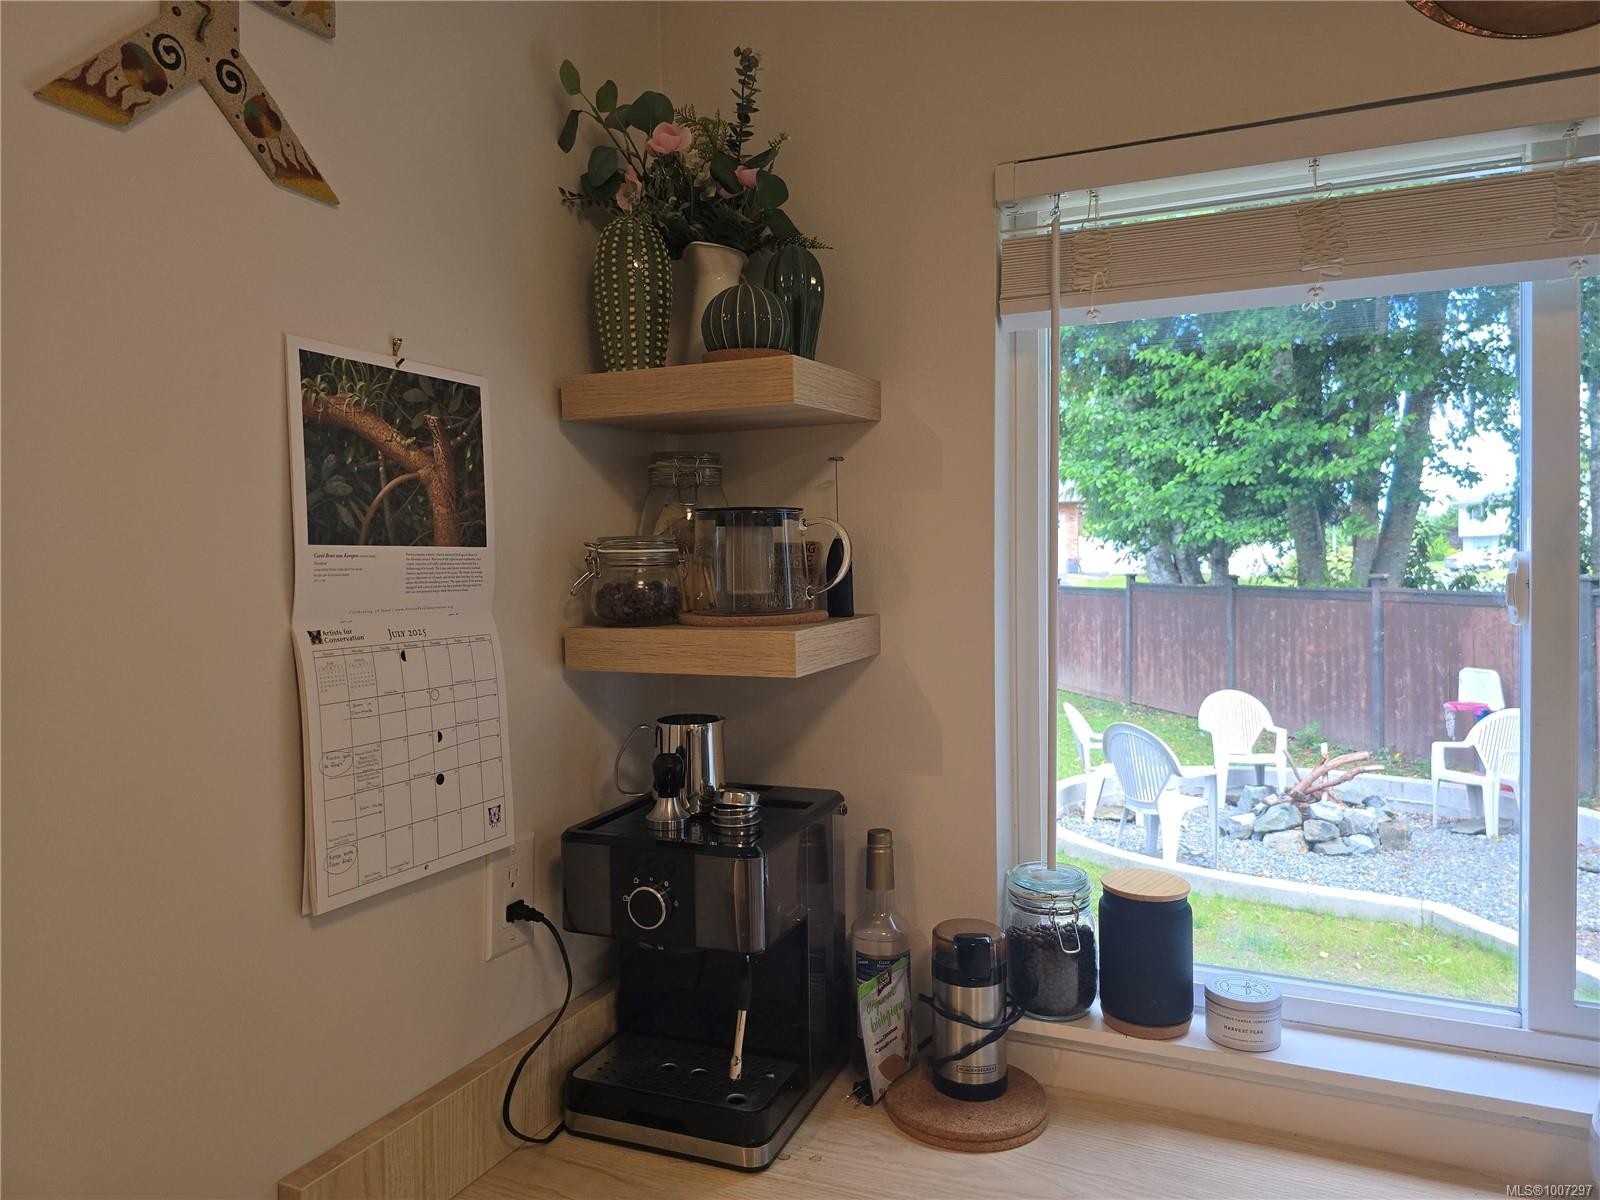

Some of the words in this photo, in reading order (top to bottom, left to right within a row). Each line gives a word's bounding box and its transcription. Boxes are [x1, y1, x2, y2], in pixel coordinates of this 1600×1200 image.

[322, 629, 343, 637] Artists
[407, 629, 427, 638] 2025
[324, 634, 365, 644] Conservation
[1223, 1024, 1249, 1034] HARVEST
